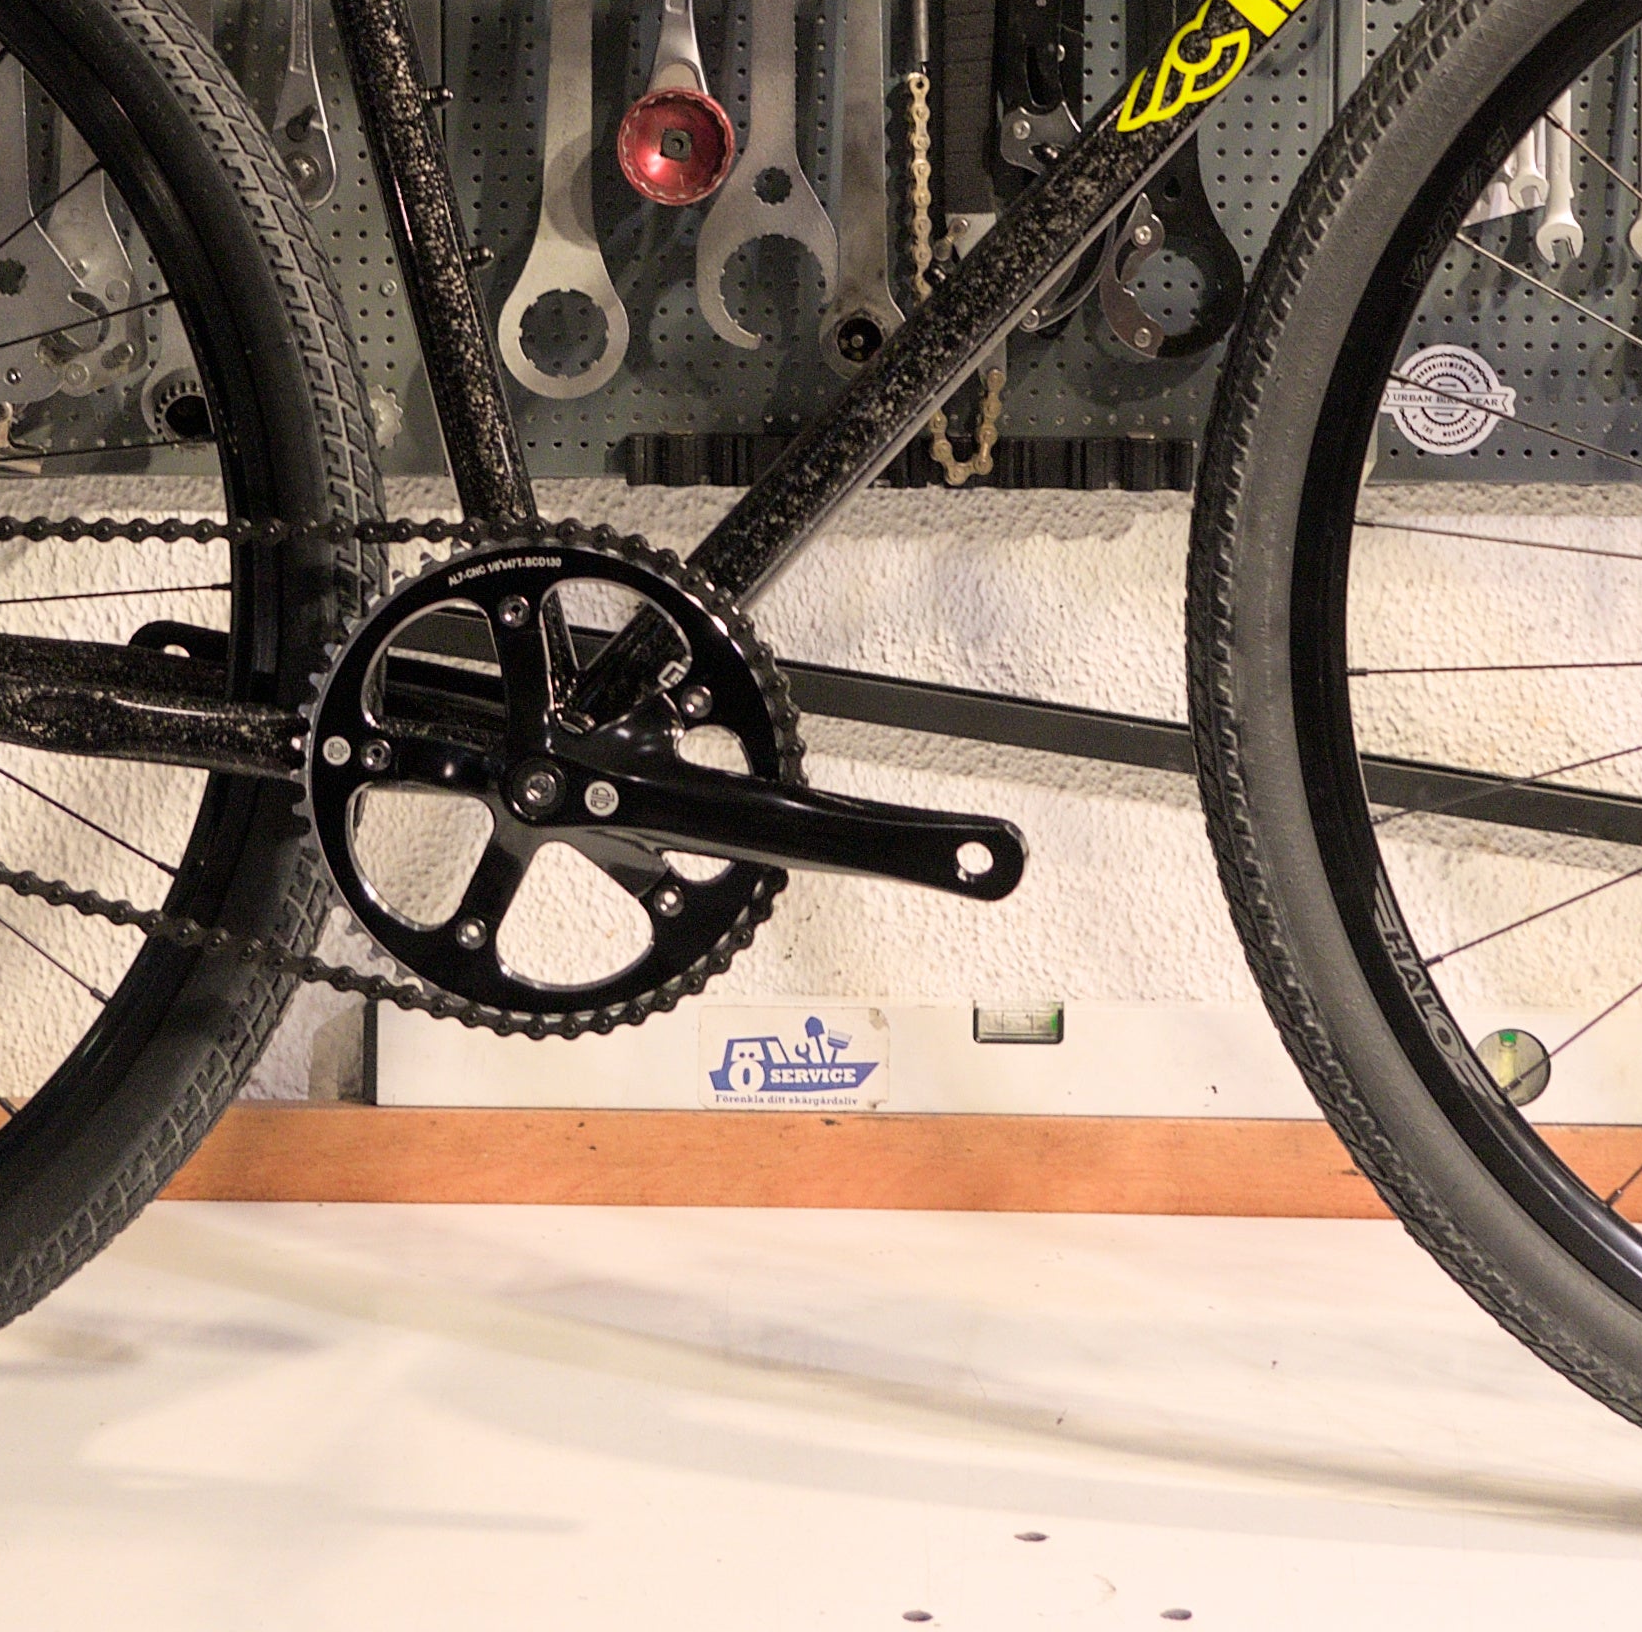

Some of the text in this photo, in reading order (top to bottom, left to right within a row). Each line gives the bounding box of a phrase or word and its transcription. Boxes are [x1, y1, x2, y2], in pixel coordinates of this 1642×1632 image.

[1392, 393, 1433, 404] URBAN
[1378, 929, 1463, 1059] HALO
[769, 1068, 857, 1084] SERVICE
[715, 1093, 859, 1107] Förenkla ditt skärgårdsliv
